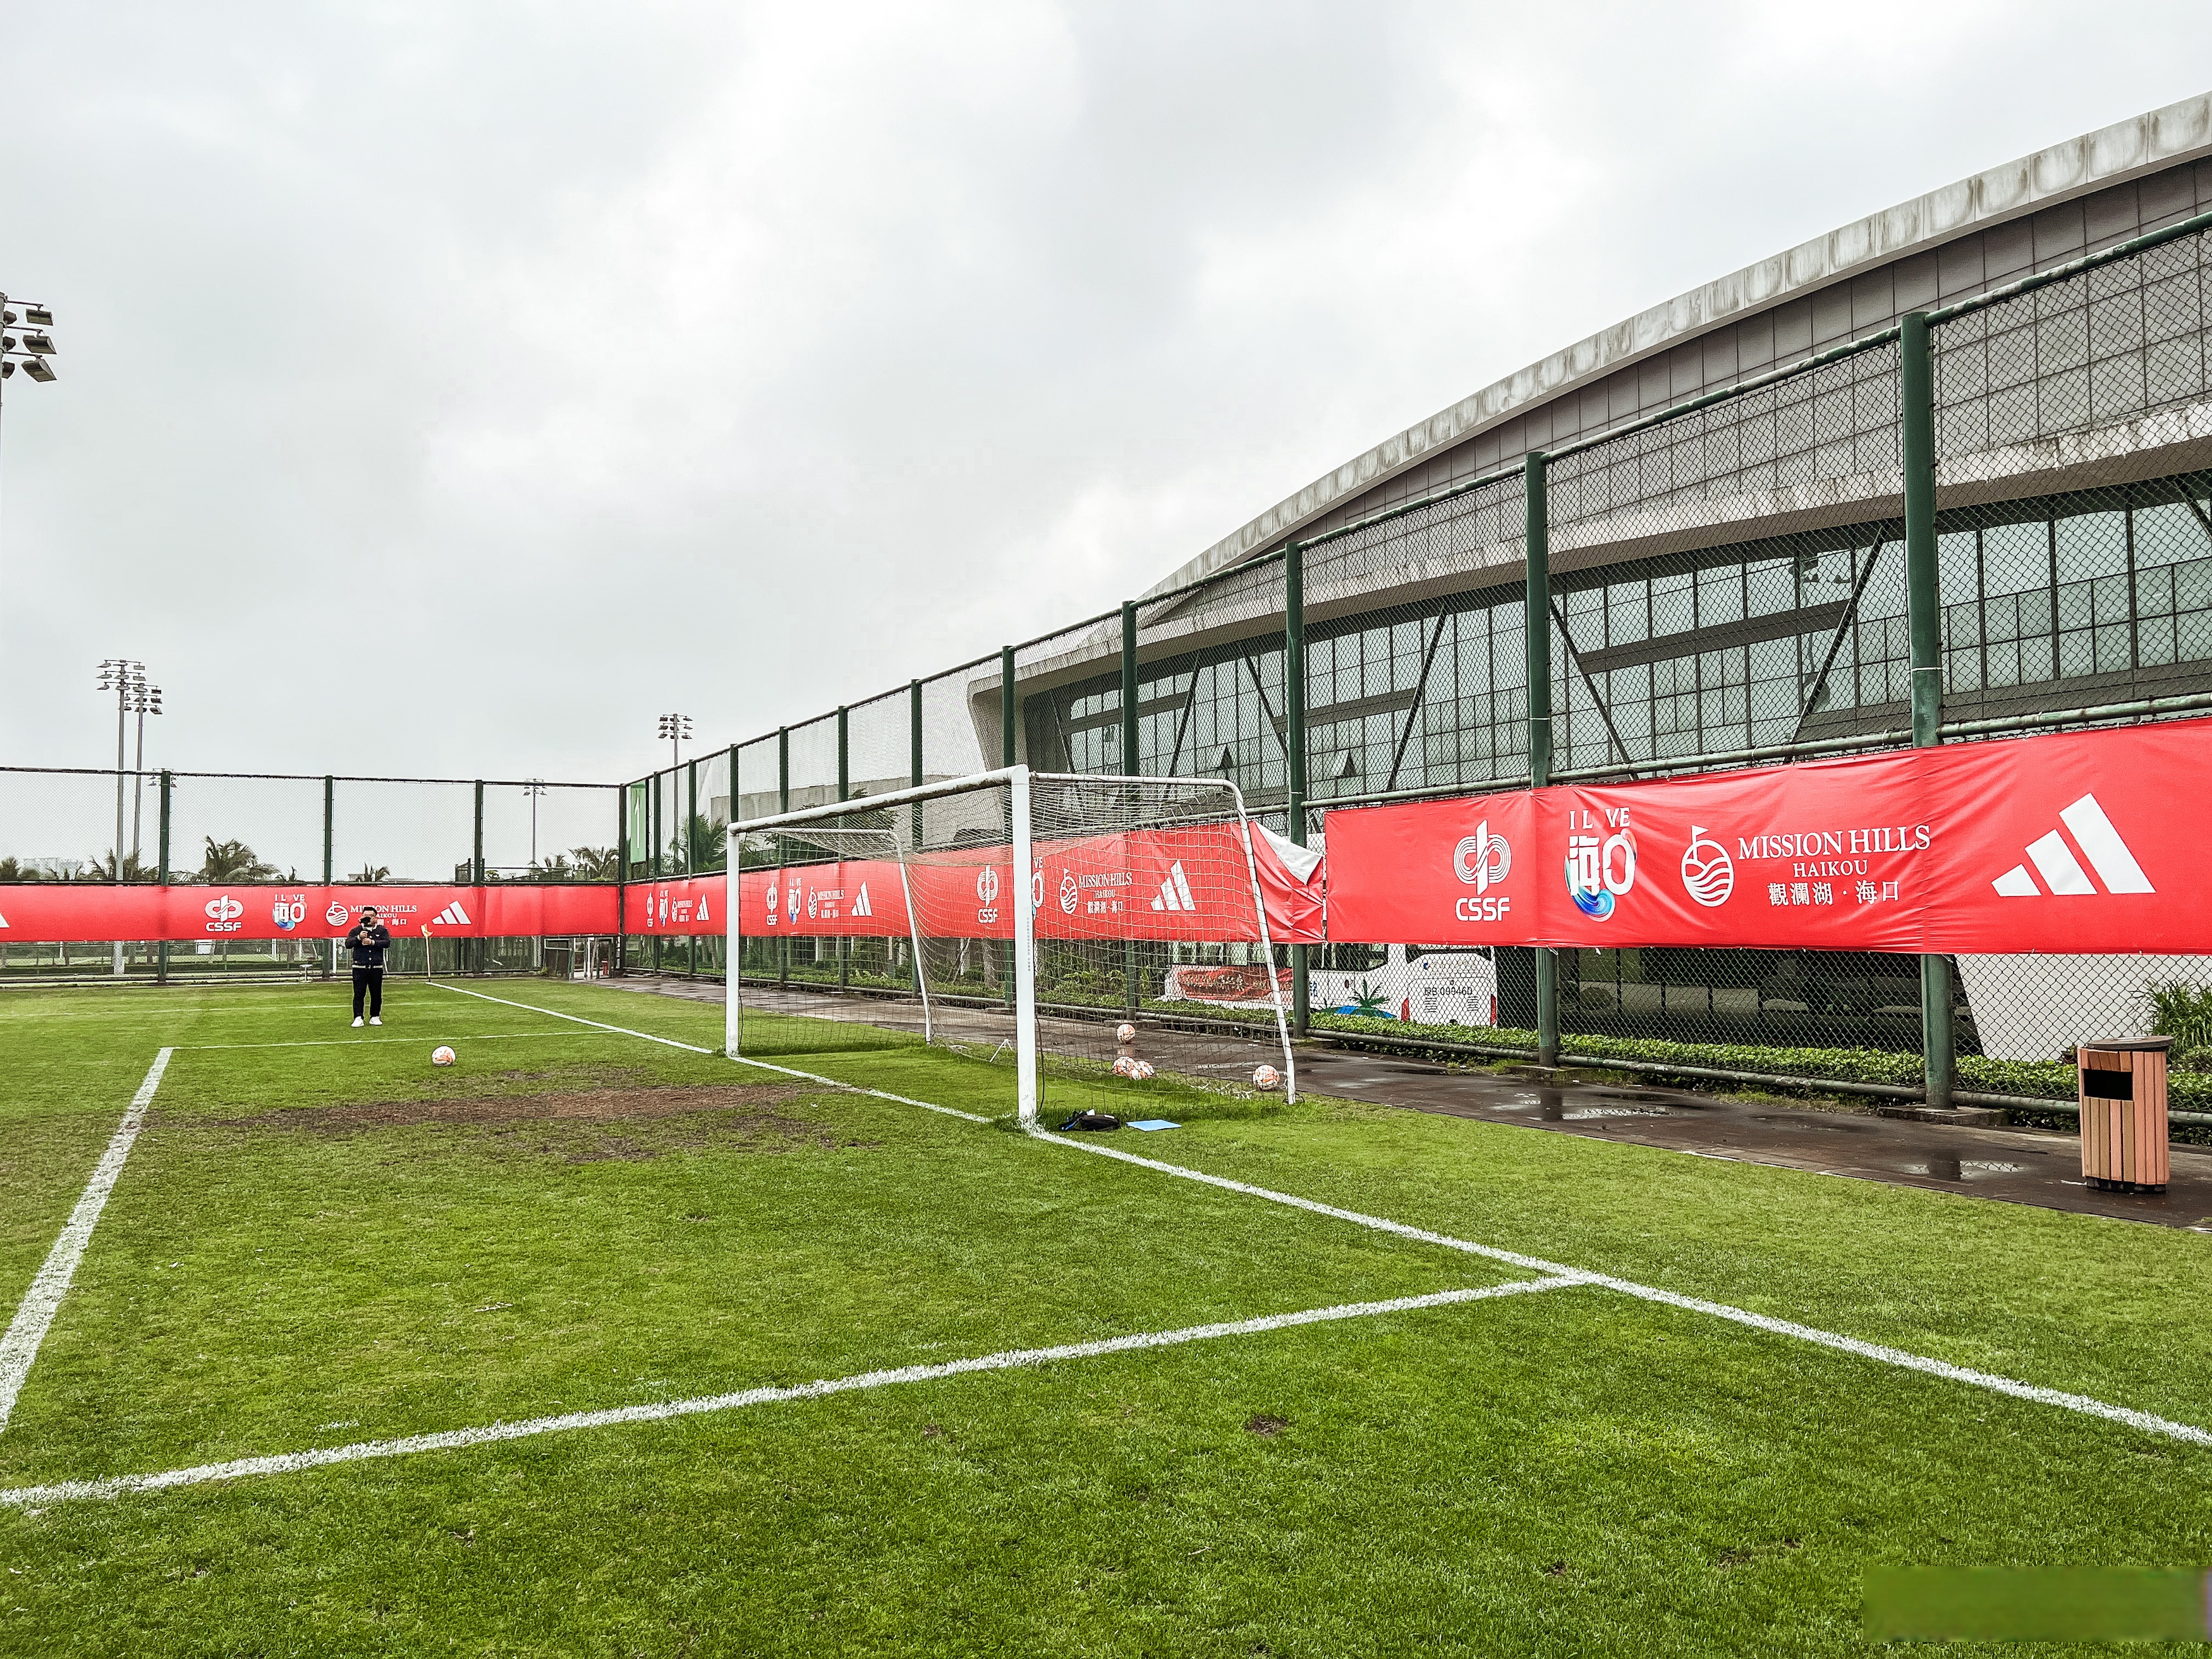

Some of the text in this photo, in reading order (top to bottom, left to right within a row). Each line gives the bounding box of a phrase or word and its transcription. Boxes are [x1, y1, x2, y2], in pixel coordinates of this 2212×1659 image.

[1569, 807, 1631, 830] I LVE
[1738, 824, 1931, 861] MISSION HILLS
[1793, 859, 1869, 878] HAIKOU
[1078, 872, 1133, 889] MISSION HILLS
[391, 904, 417, 913] HILLS
[978, 908, 998, 923] CSSF
[1455, 896, 1510, 922] CSSF
[205, 921, 242, 932] CSSF
